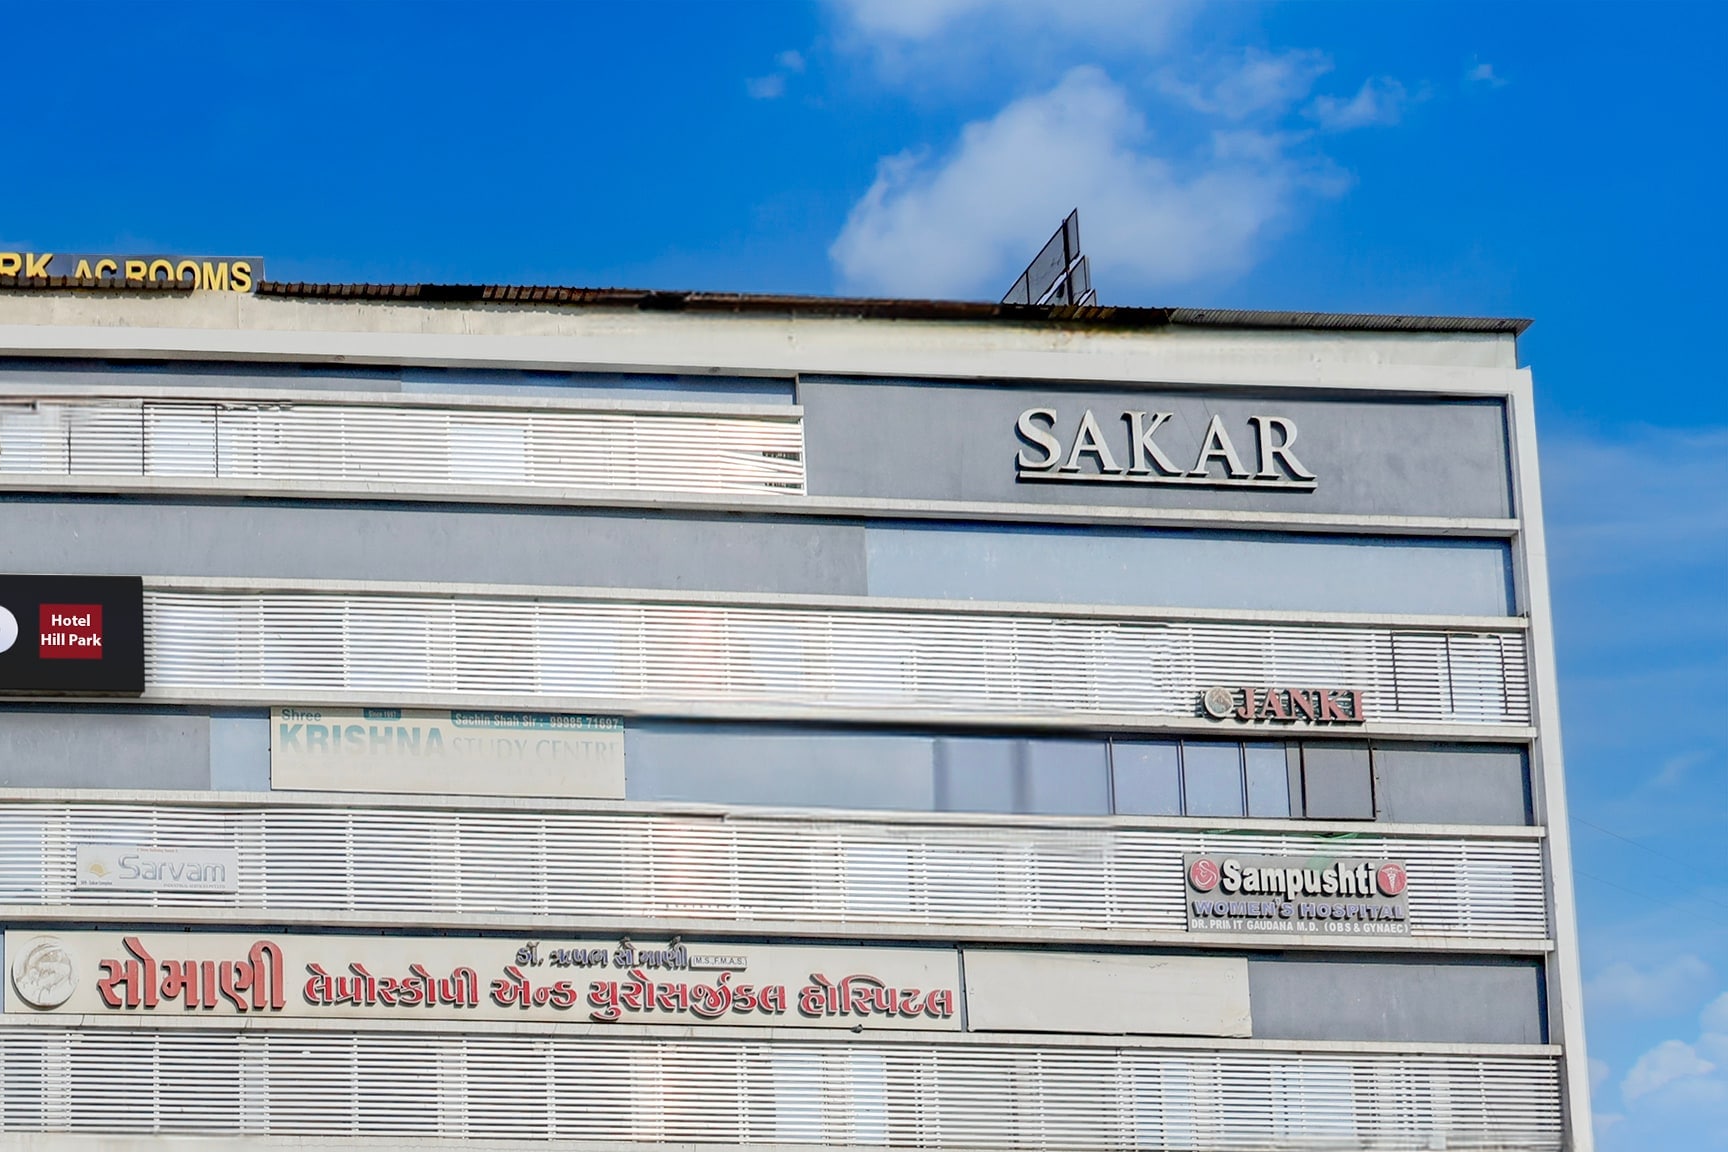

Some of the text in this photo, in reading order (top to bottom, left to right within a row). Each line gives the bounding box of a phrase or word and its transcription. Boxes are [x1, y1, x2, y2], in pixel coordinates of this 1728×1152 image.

[125, 259, 252, 293] ROOMS
[1018, 408, 1317, 479] SAKAR
[51, 614, 91, 627] Hotel
[41, 634, 102, 647] Hill Park
[282, 709, 321, 721] Shree
[1238, 687, 1365, 722] JANKI
[456, 713, 537, 727] Sachin Shah Sir
[279, 724, 445, 755] KRISHNA
[118, 855, 226, 883] Sarvam
[1222, 858, 1376, 900] Sampushti
[1191, 919, 1208, 929] DR.
[1247, 920, 1293, 931] GAUDANA
[1297, 921, 1319, 931] M.D.
[1300, 902, 1405, 920] HOSPITAL
[97, 937, 284, 1011] સોમાણી
[491, 965, 578, 1009] એન્ડ
[799, 973, 954, 1017] હોસ્પિટલ
